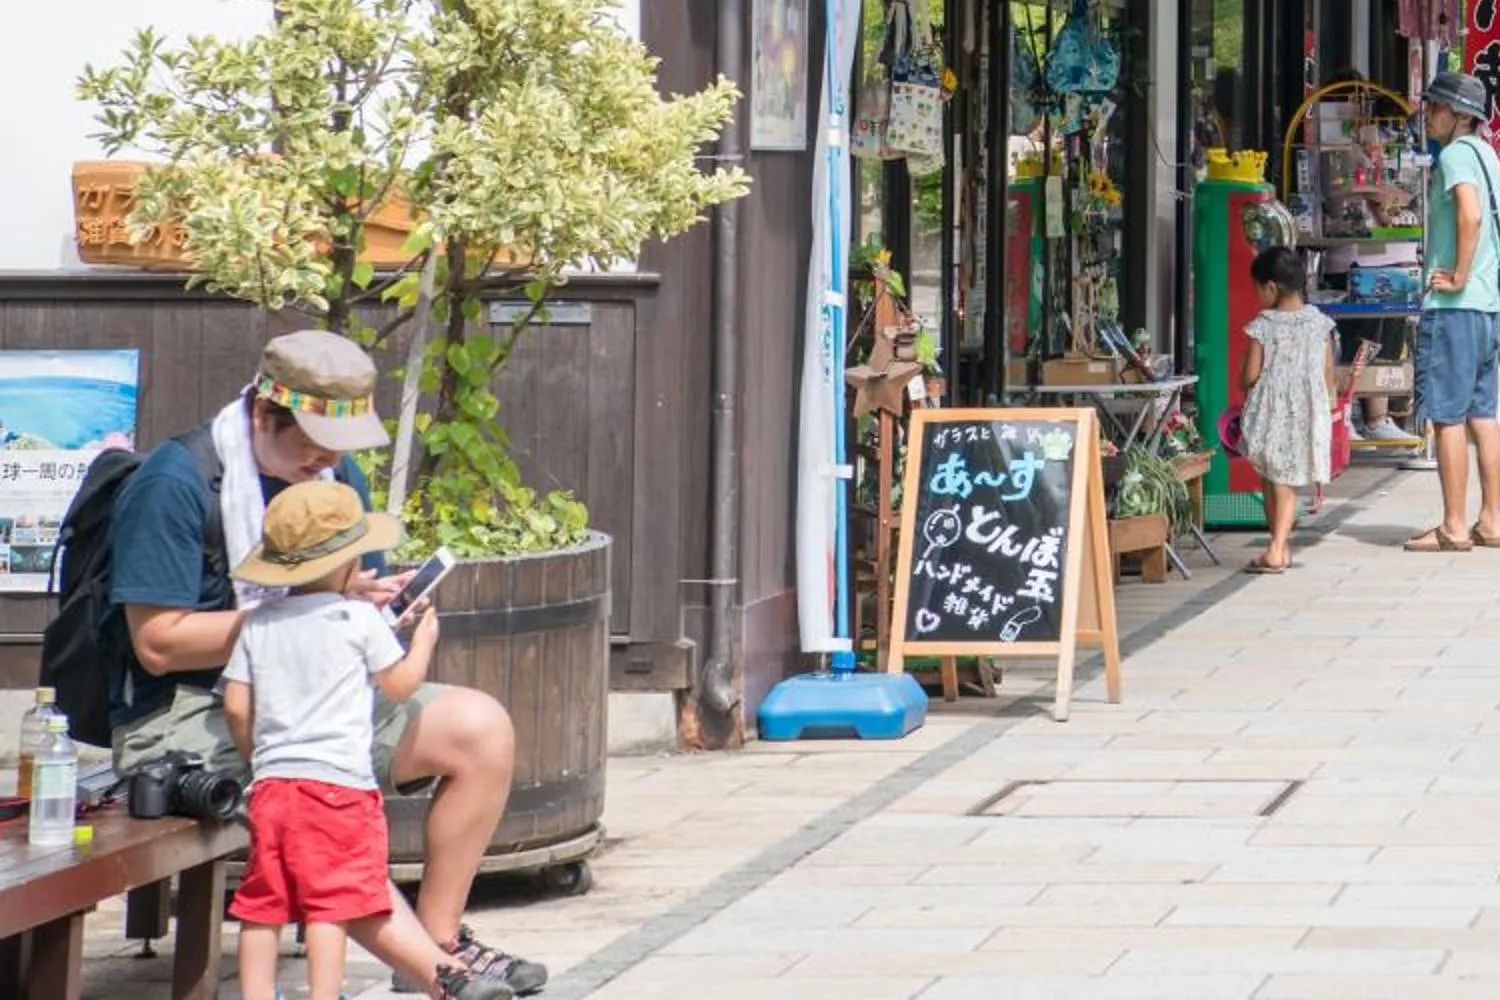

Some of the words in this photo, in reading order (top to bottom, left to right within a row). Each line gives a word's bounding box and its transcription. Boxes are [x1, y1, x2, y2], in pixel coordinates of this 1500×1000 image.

[913, 559, 1015, 616] ハンドメイド
